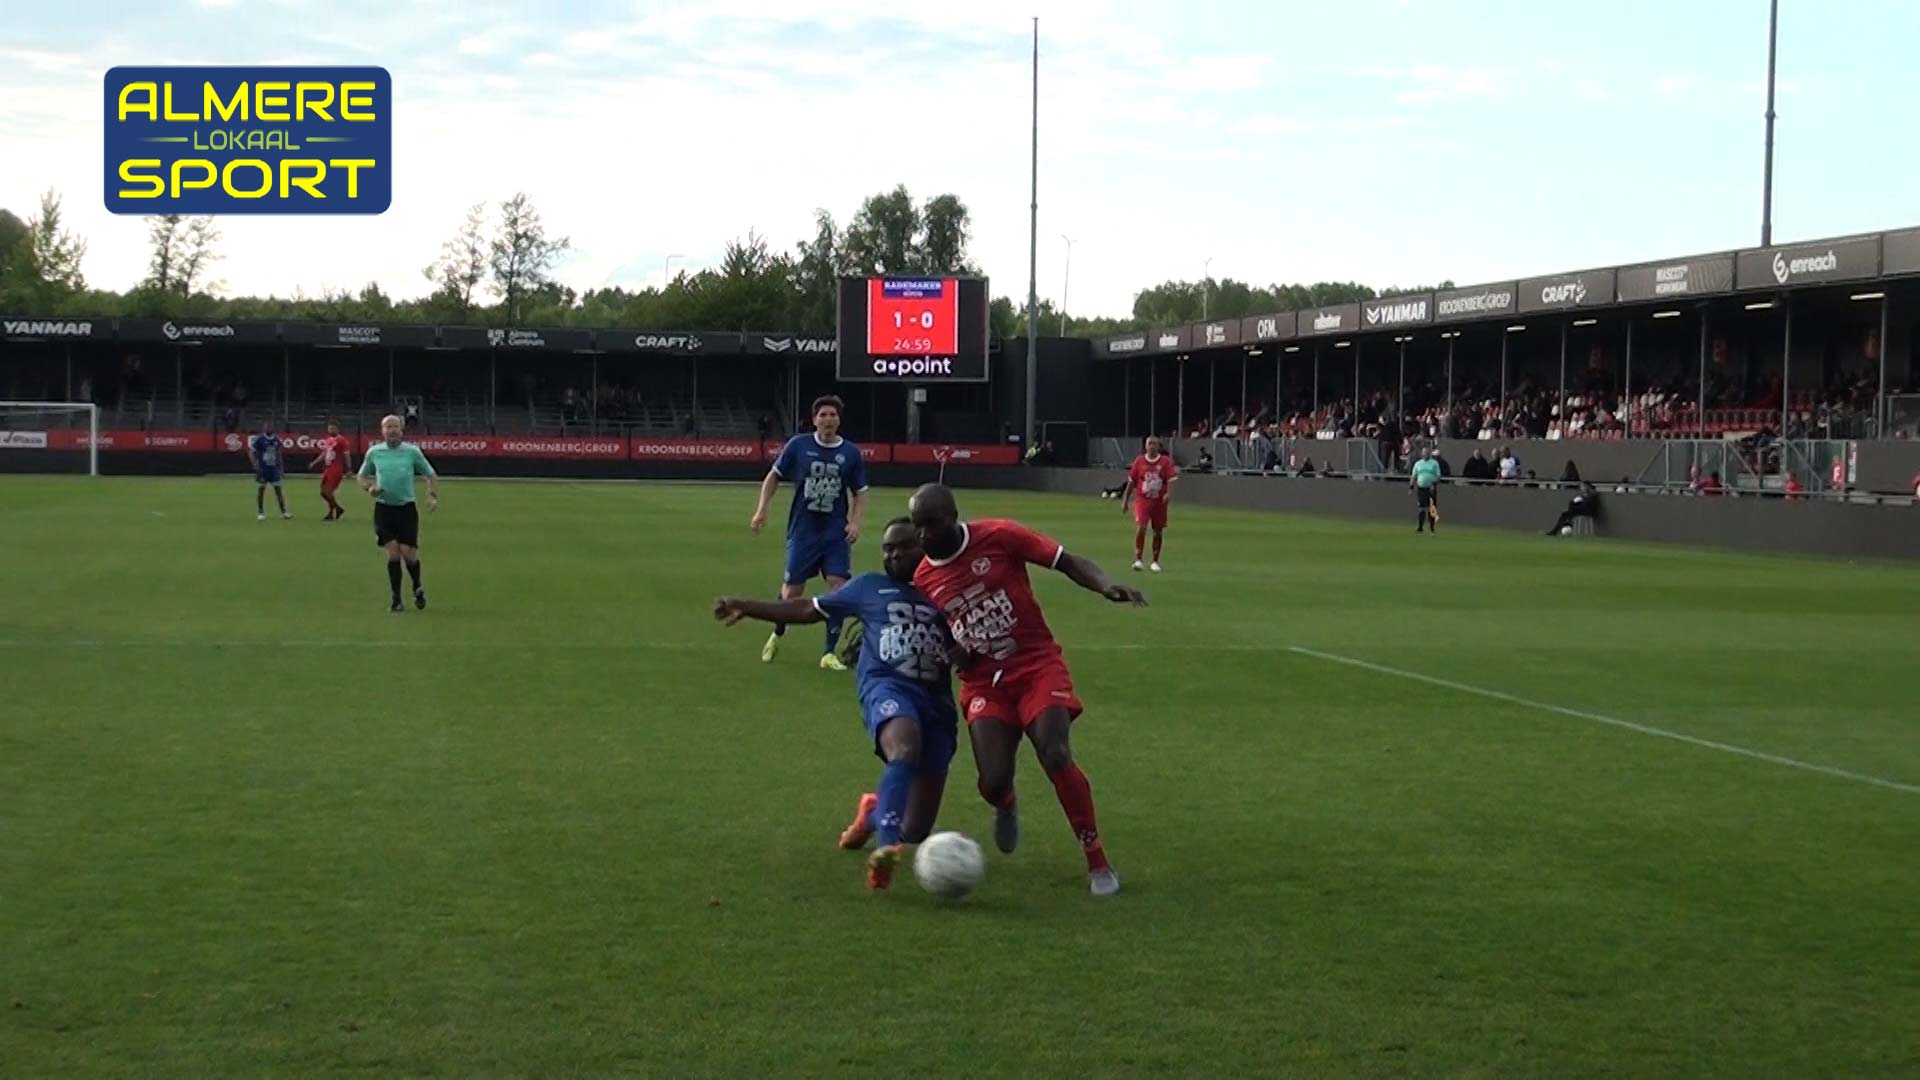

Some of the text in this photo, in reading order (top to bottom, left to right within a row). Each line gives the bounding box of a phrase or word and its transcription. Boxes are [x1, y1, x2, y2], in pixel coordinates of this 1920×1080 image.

[1790, 250, 1837, 275] enreach
[1541, 282, 1577, 304] CRAFT
[893, 311, 902, 328] 1
[920, 311, 933, 328] 0
[1381, 301, 1426, 324] YANMAR
[3, 321, 93, 335] YANMAR
[183, 325, 235, 337] enreach
[635, 335, 688, 348] CRAFT
[893, 339, 932, 351] 24:59
